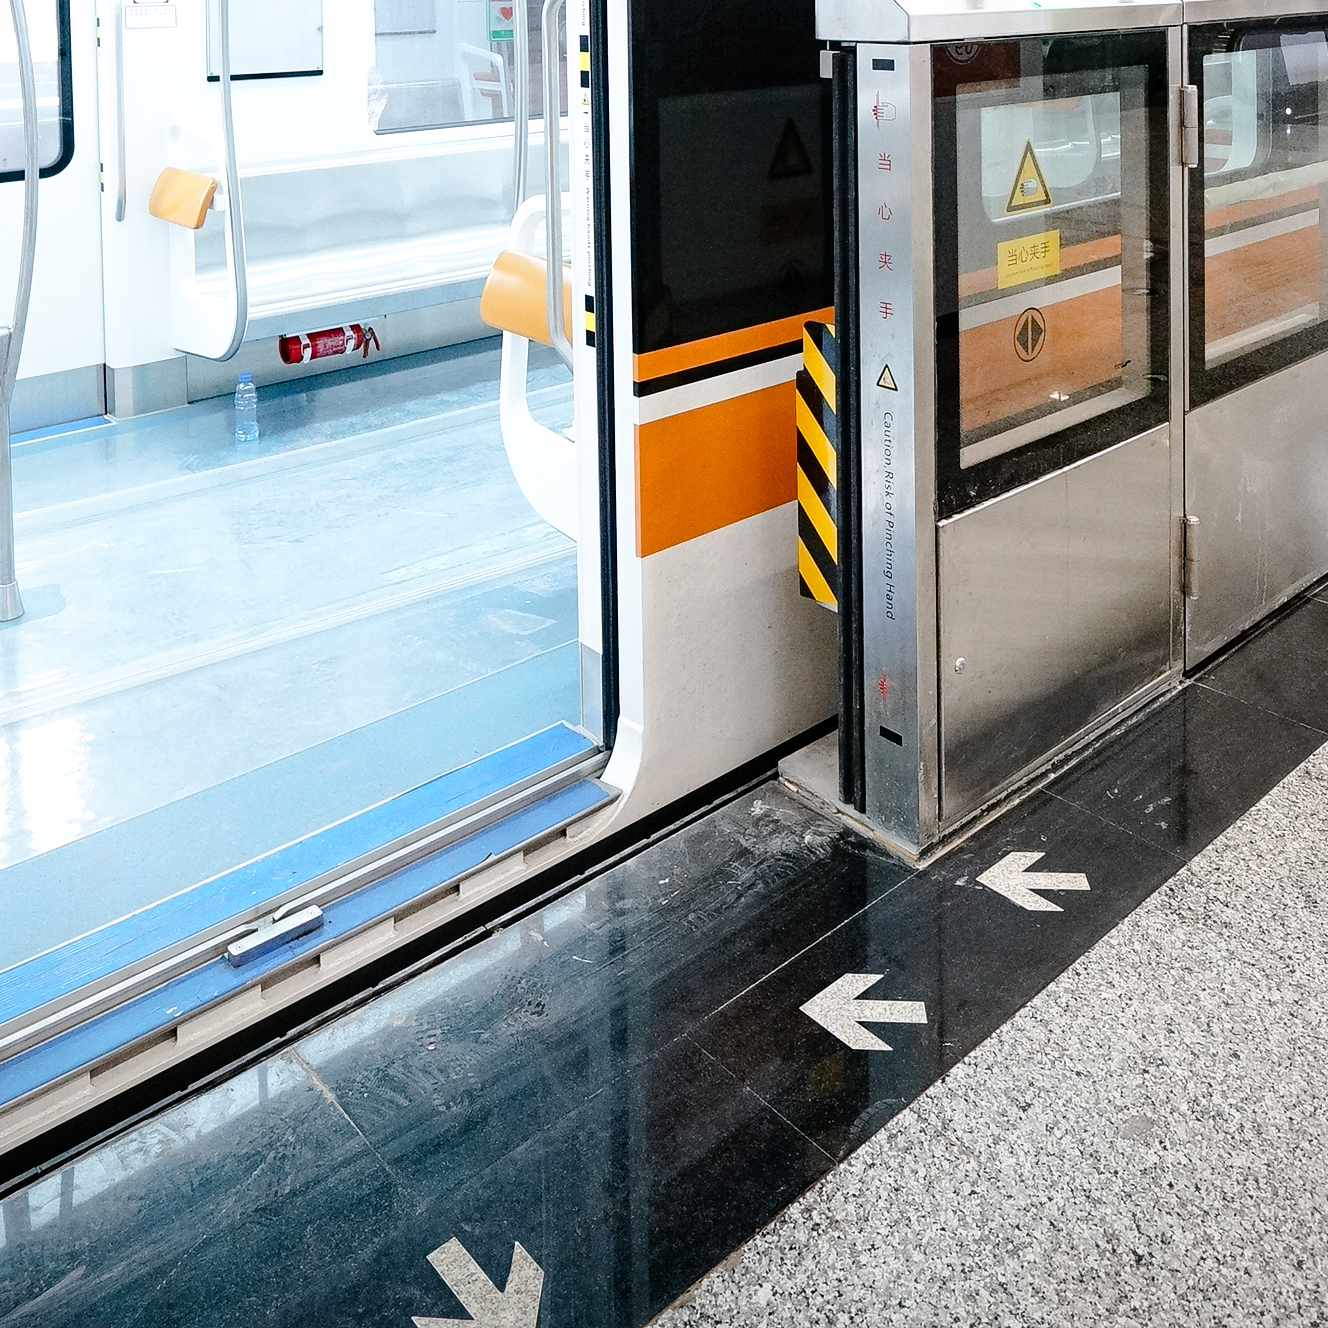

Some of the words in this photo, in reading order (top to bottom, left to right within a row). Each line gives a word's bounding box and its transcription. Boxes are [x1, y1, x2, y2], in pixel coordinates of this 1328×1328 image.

[878, 152, 893, 320] 当心夹手
[1007, 240, 1051, 267] 当心夹手
[884, 500, 895, 518] of
[883, 519, 895, 580] Pinching
[885, 584, 896, 621] Hand
